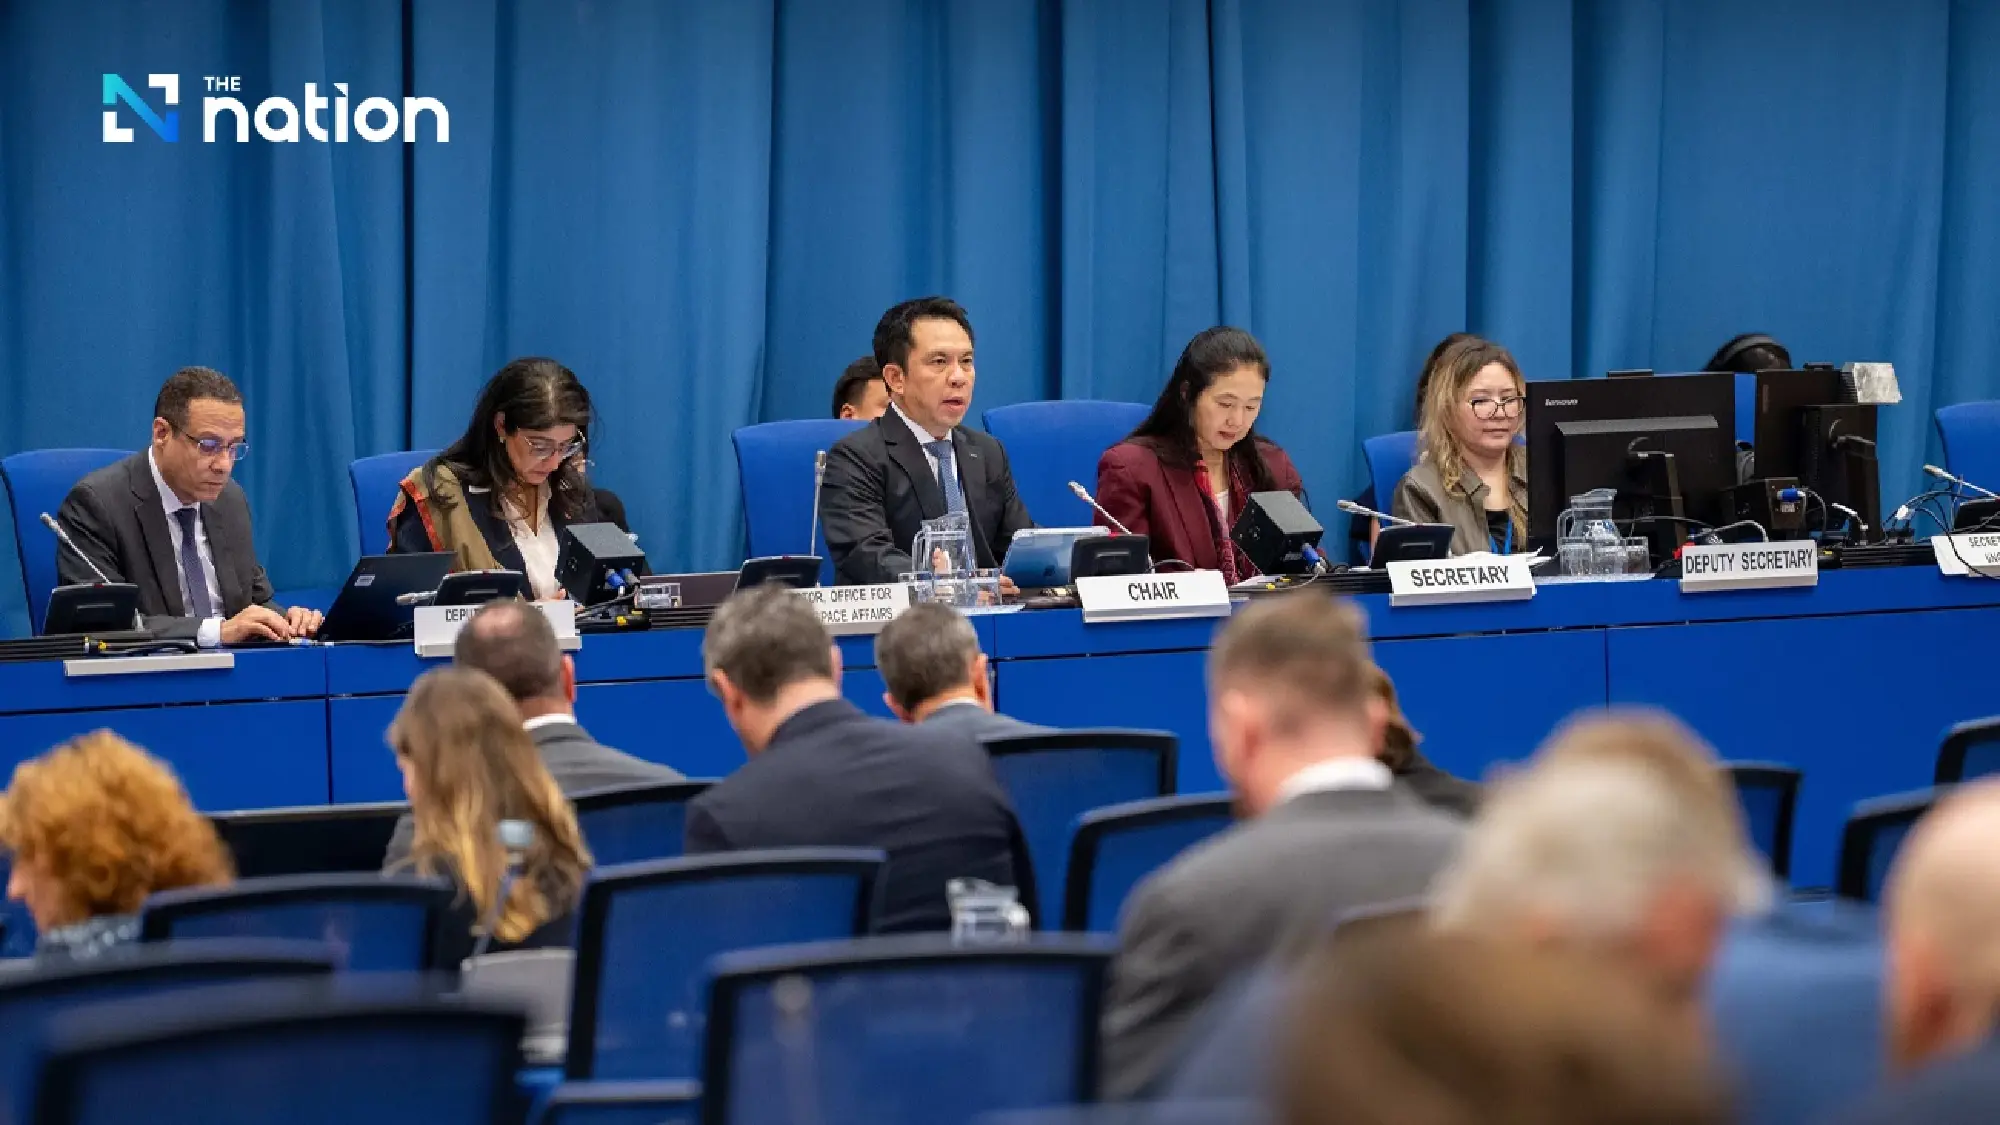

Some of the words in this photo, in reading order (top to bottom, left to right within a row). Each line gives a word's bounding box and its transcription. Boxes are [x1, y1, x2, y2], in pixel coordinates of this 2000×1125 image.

[1685, 553, 1735, 574] DEPUTY
[1741, 548, 1813, 571] SECRETARY
[1410, 565, 1509, 588] SECRETARY
[830, 588, 867, 602] OFFICE
[870, 587, 892, 600] FOR
[1128, 581, 1180, 602] CHAIR
[851, 607, 893, 621] AFFAIRS
